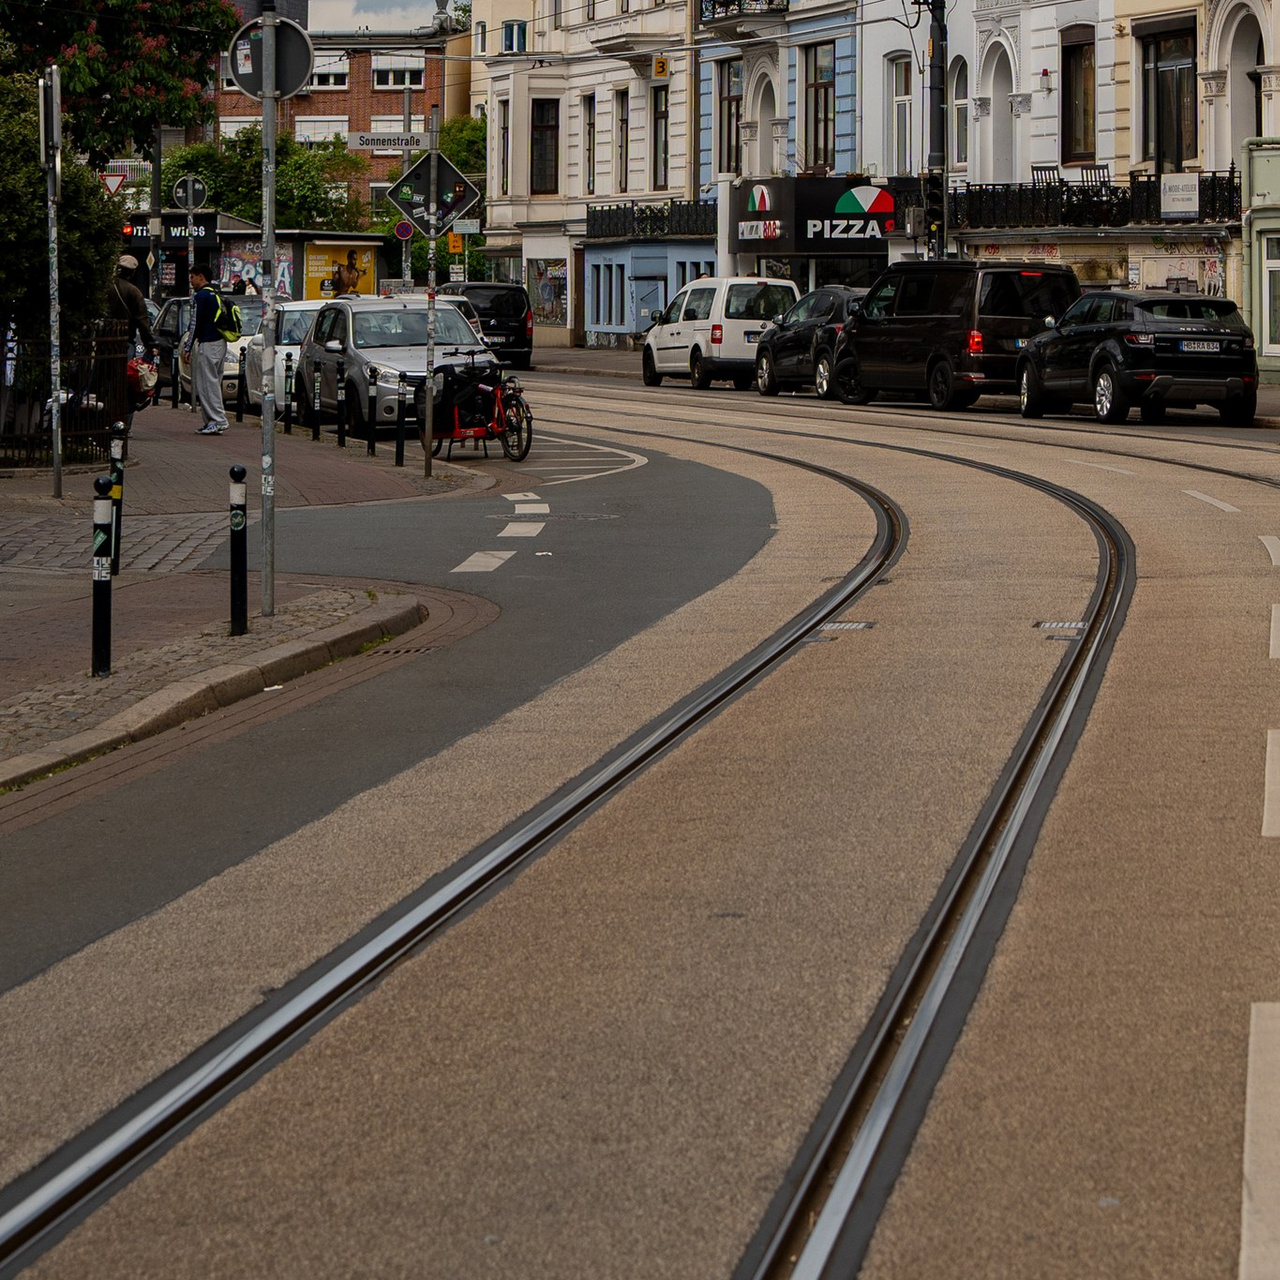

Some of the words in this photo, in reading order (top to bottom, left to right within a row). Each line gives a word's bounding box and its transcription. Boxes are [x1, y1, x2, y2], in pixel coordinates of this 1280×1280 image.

[657, 61, 665, 74] 3
[359, 135, 421, 147] Sonnenstraße
[807, 219, 882, 239] PIZZA
[1183, 342, 1193, 350] HB
[1197, 342, 1205, 350] RA
[1206, 342, 1219, 351] 834
